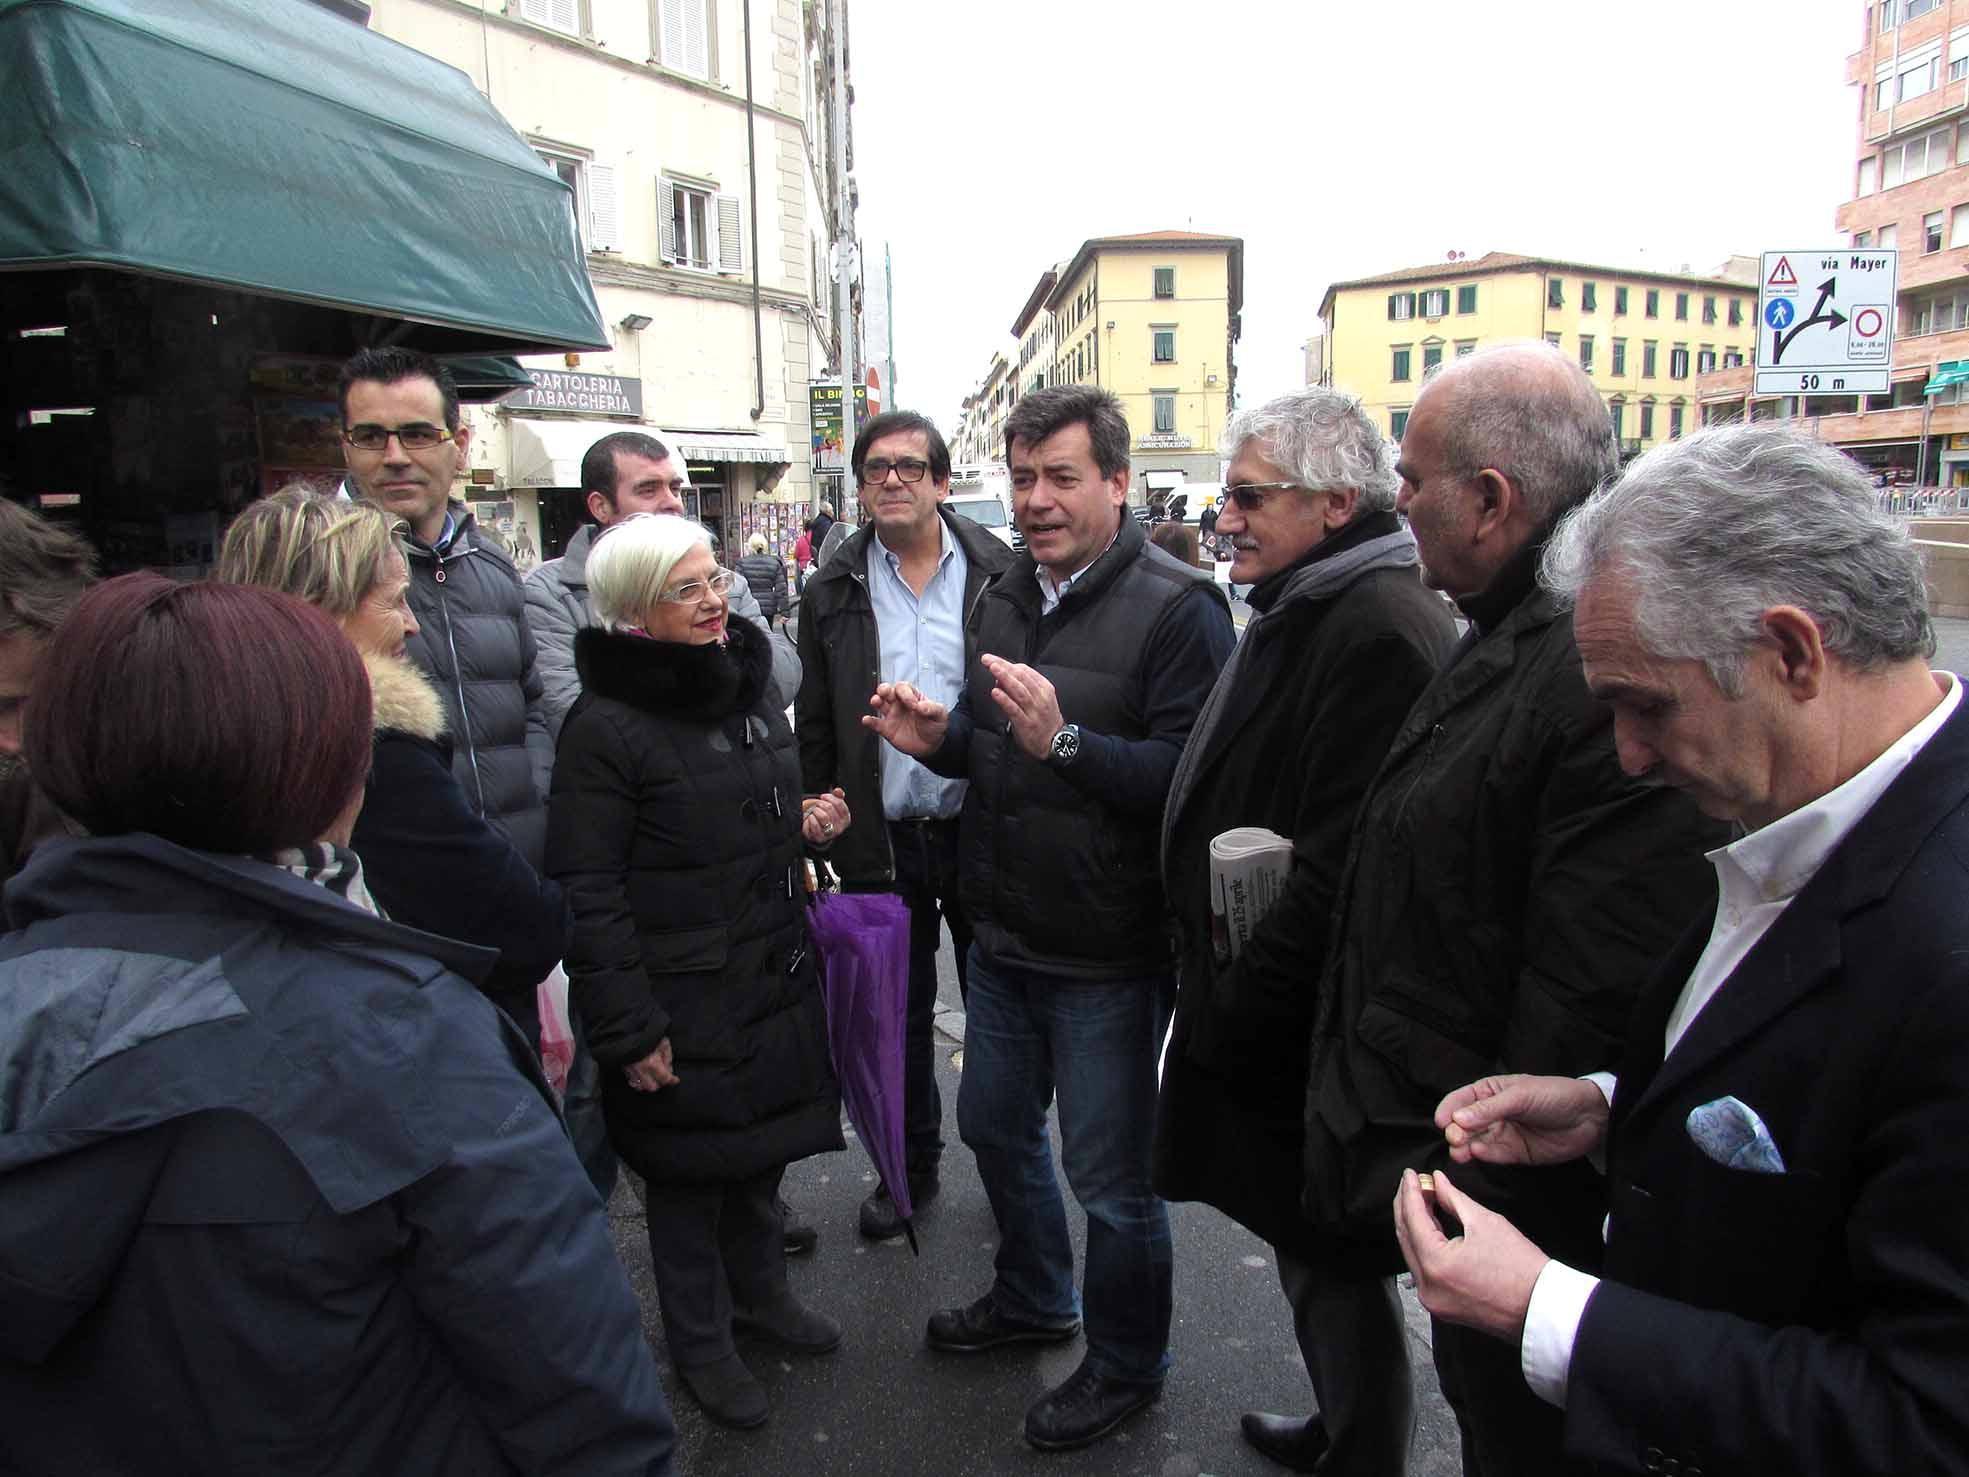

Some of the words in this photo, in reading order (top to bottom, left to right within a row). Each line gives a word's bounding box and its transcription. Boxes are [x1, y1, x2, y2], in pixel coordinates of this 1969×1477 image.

[1820, 257, 1839, 270] via
[1850, 256, 1887, 273] Mayer
[530, 372, 623, 395] CARTOLERIA
[1800, 374, 1819, 391] 50
[1833, 378, 1845, 390] m
[526, 389, 631, 412] TABACCHERIA
[814, 389, 825, 400] IL
[827, 389, 865, 400] BIO
